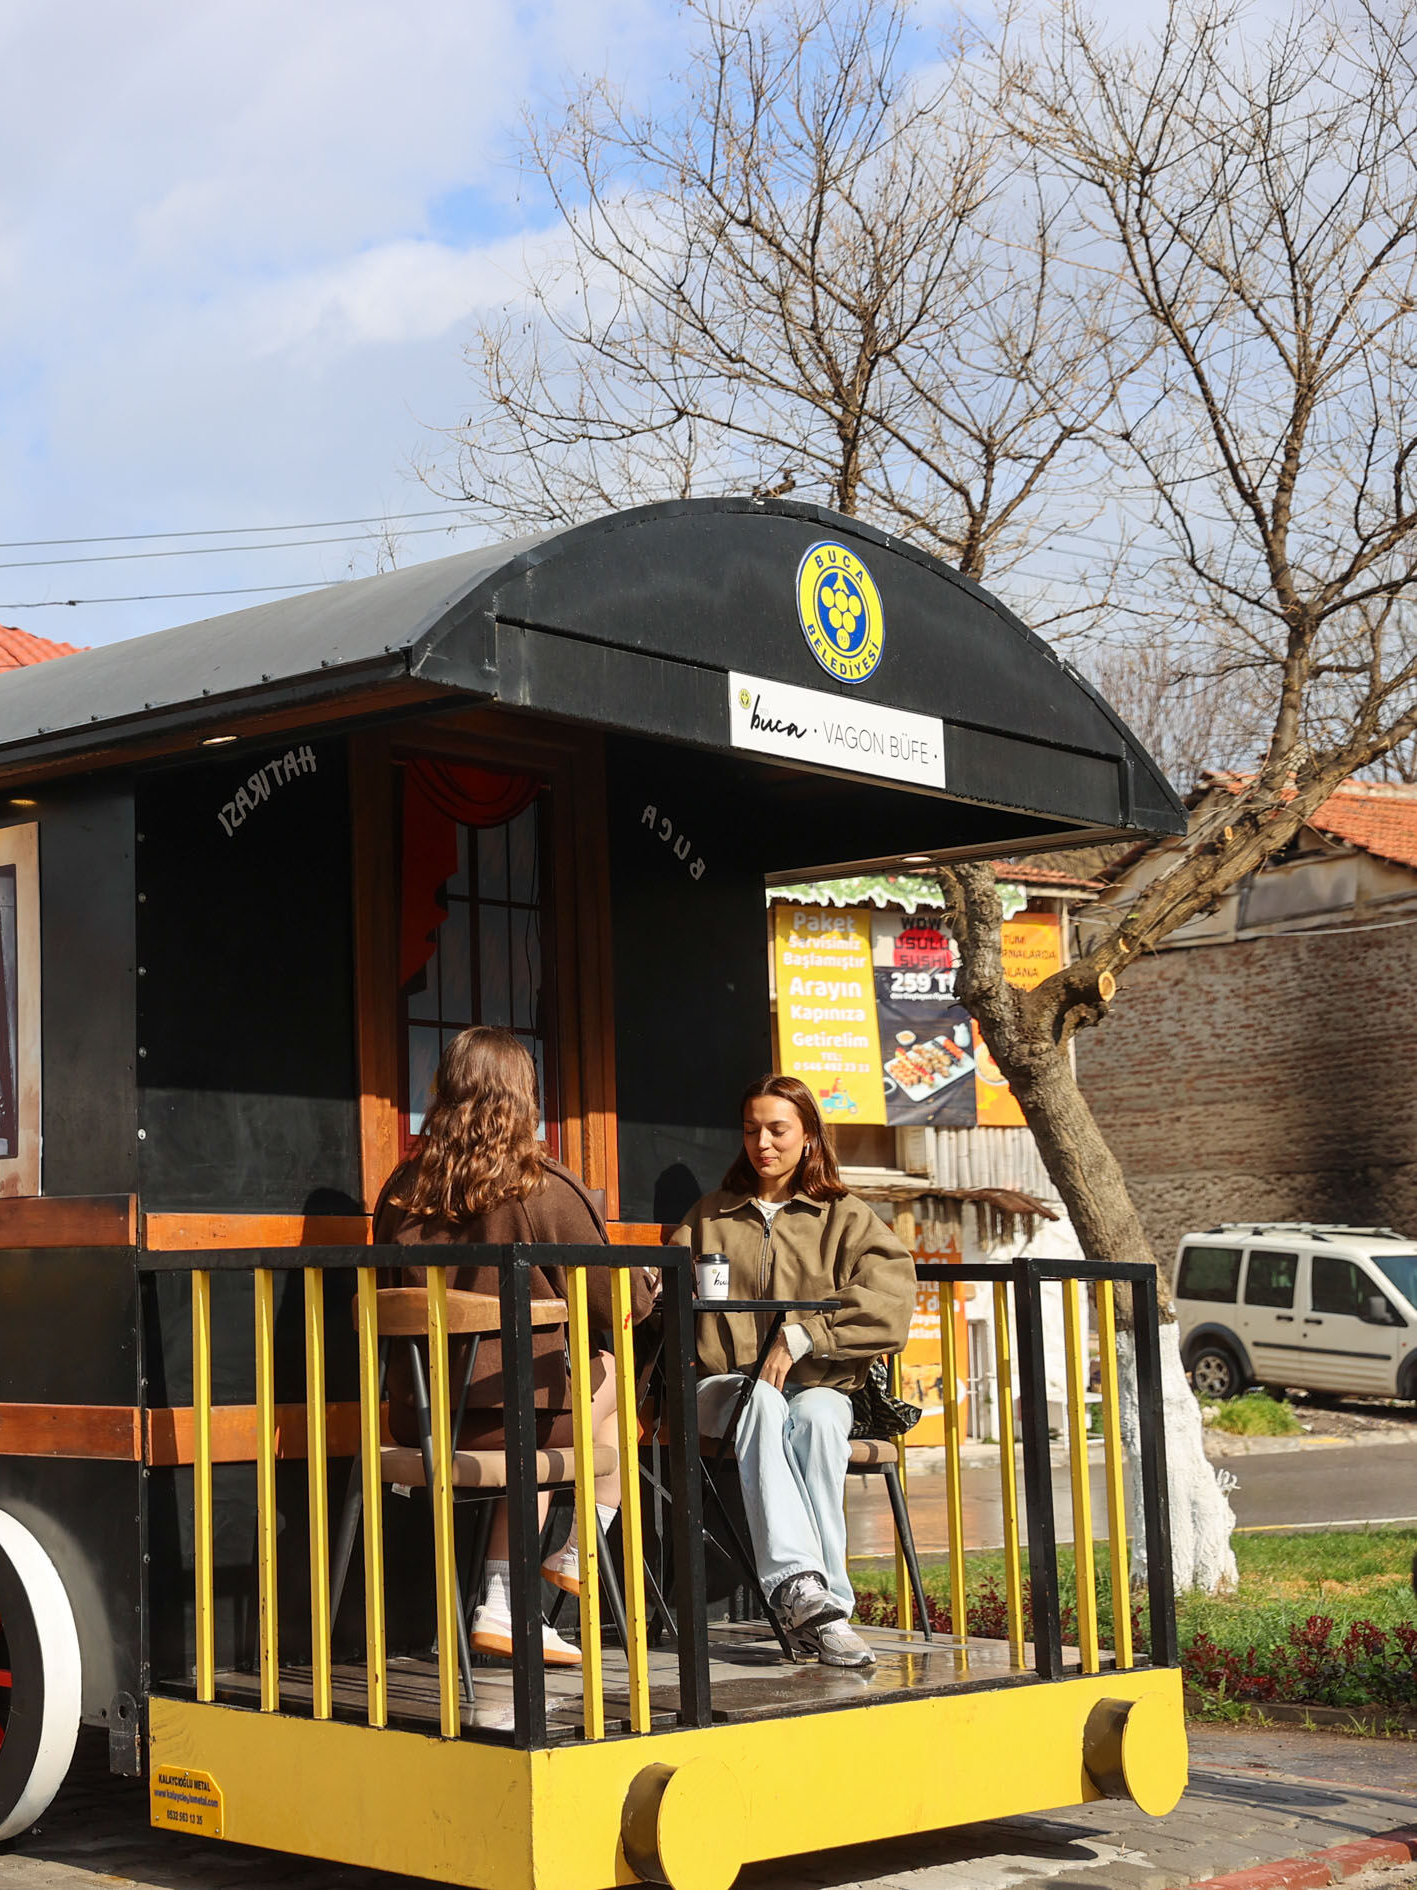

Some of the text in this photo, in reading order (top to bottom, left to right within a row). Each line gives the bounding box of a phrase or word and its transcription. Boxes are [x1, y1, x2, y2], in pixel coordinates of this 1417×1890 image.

[814, 550, 863, 582] BUCA
[807, 624, 879, 677] BELEDİYESİ
[750, 694, 929, 764] buca VAGON BÜFE
[793, 911, 856, 932] Paket
[901, 916, 942, 930] WOW
[788, 935, 861, 950] Servisimiz
[783, 952, 866, 970] Başlamıştır
[789, 976, 862, 1001] Arayın
[890, 972, 932, 993] 259
[790, 1005, 866, 1023] Kapınıza
[792, 1032, 869, 1048] Getirelim
[194, 1779, 211, 1793] METAL
